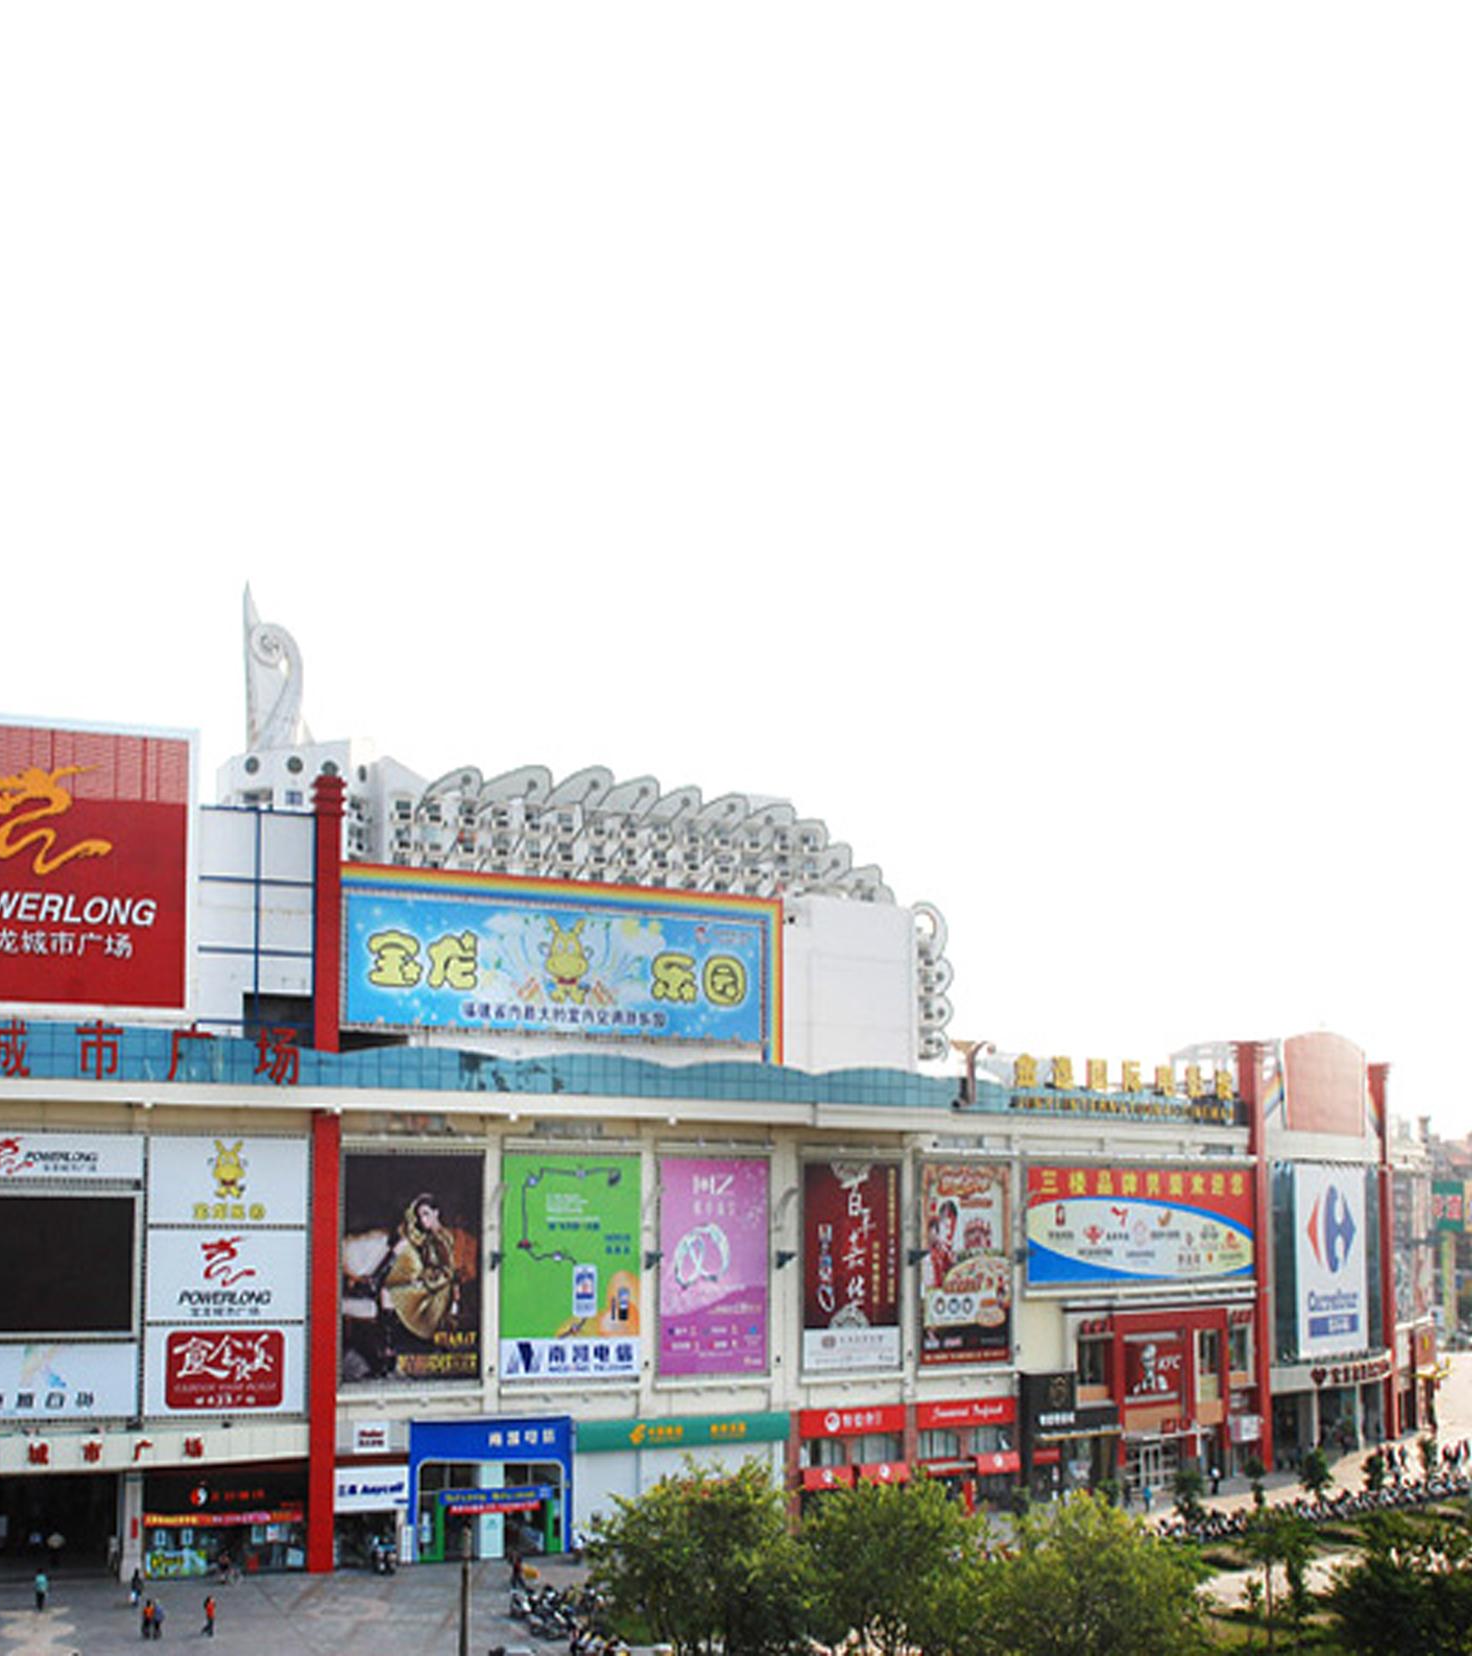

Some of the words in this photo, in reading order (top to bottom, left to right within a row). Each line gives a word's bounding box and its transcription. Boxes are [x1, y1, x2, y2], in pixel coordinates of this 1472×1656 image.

[366, 929, 479, 991] 宝龙
[650, 951, 748, 1007] 乐园
[178, 1289, 271, 1306] POWERLONG
[1157, 1355, 1182, 1370] KFC
